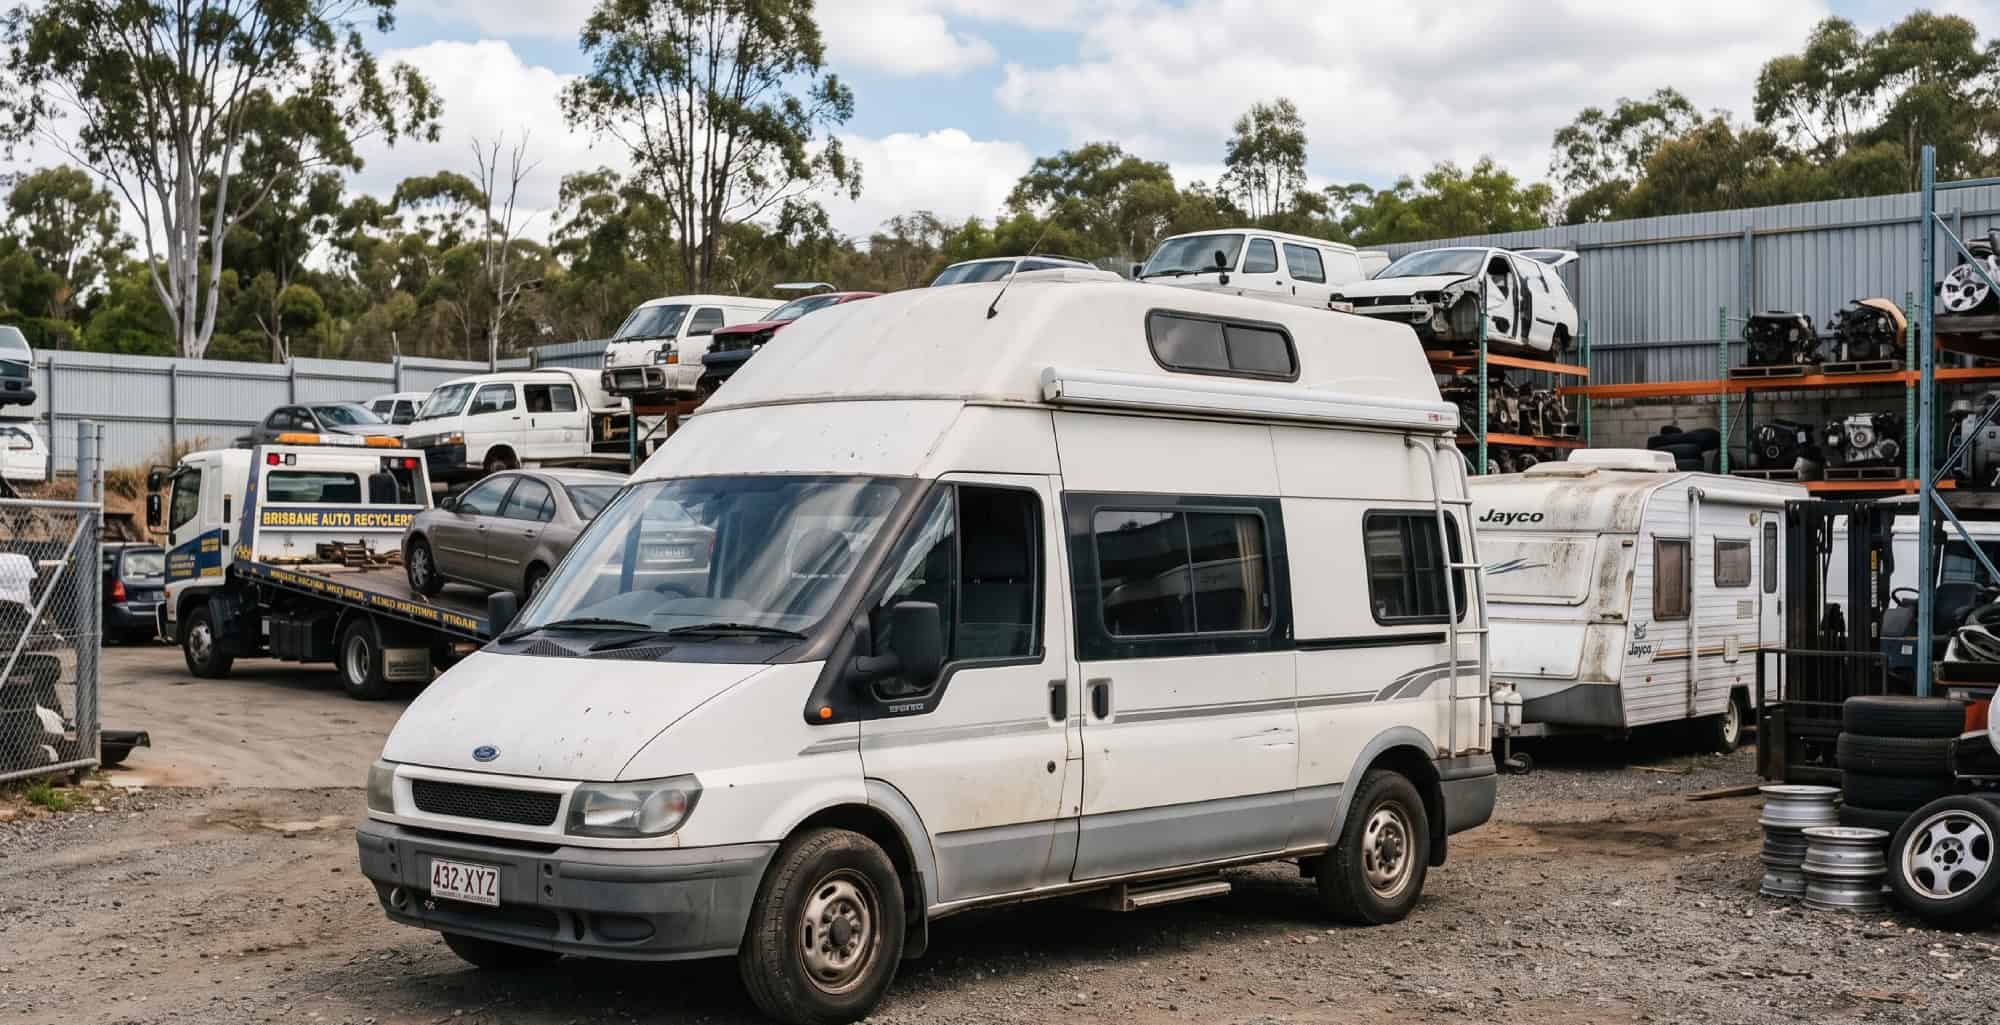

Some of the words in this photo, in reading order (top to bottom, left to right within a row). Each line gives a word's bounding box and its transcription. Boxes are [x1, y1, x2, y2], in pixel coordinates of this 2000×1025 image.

[263, 512, 318, 525] BRISBANE
[321, 513, 351, 526] AUTO
[1479, 508, 1544, 526] Jayco
[1628, 641, 1652, 659] Jayco
